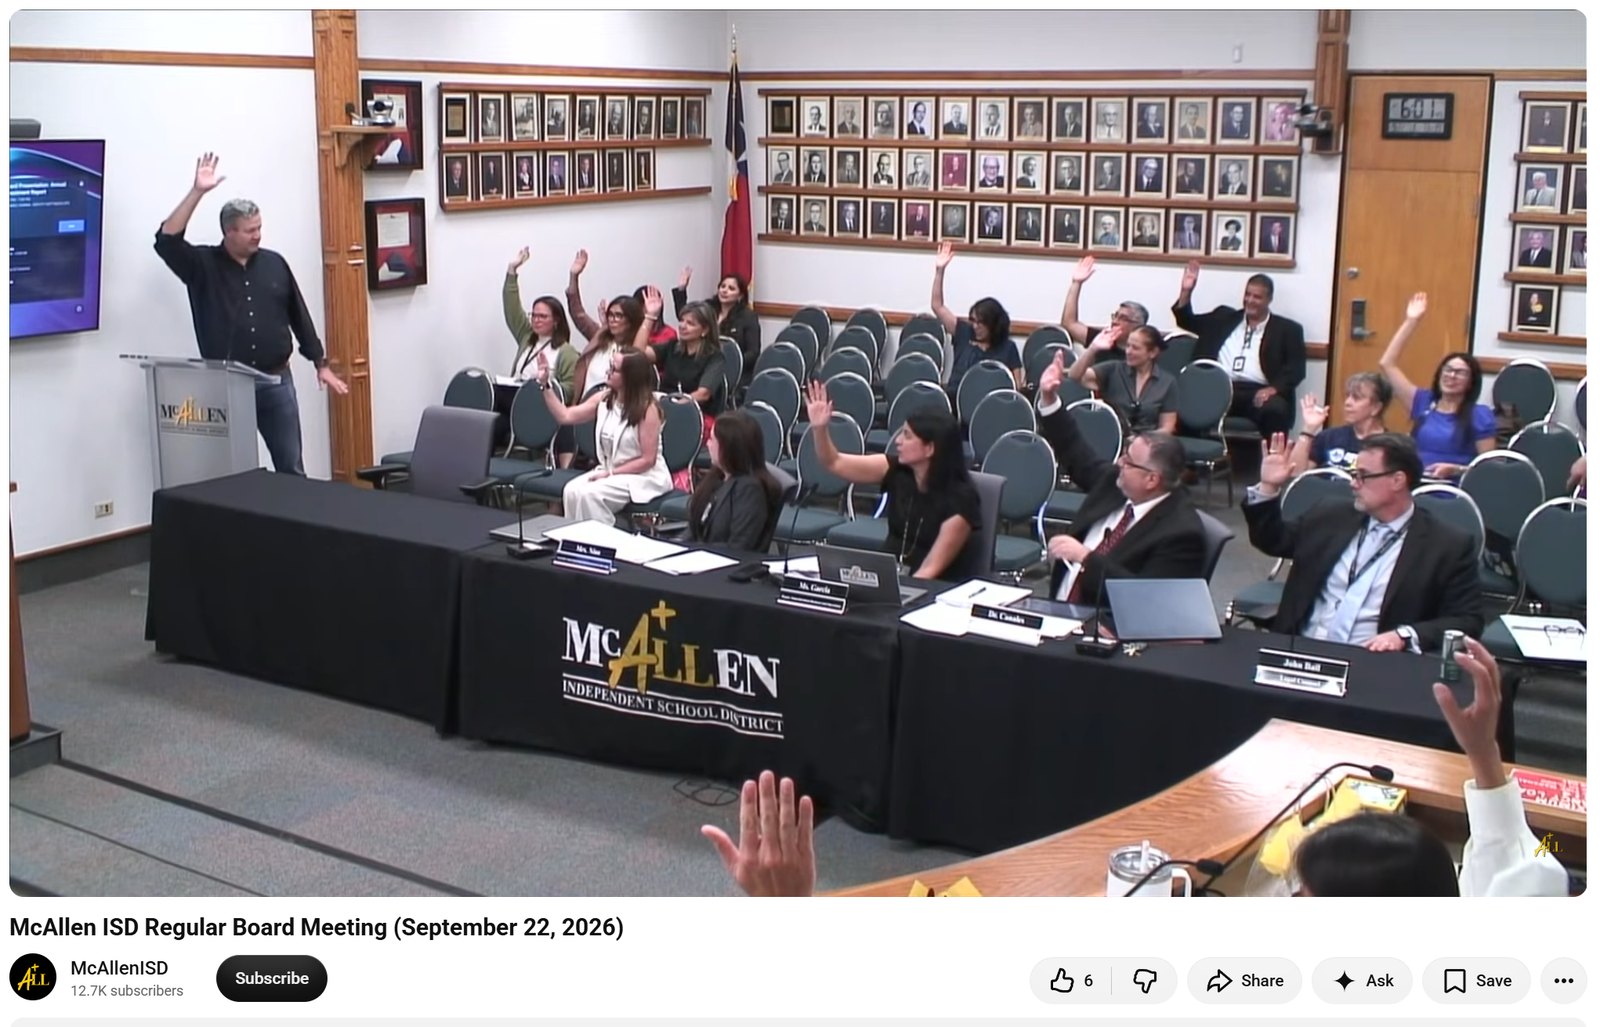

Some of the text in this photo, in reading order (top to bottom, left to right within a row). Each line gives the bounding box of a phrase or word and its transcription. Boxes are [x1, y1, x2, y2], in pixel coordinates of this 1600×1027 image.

[1283, 658, 1303, 670] John
[562, 679, 784, 732] INDEPENDENT SCHOOL DISTRICT
